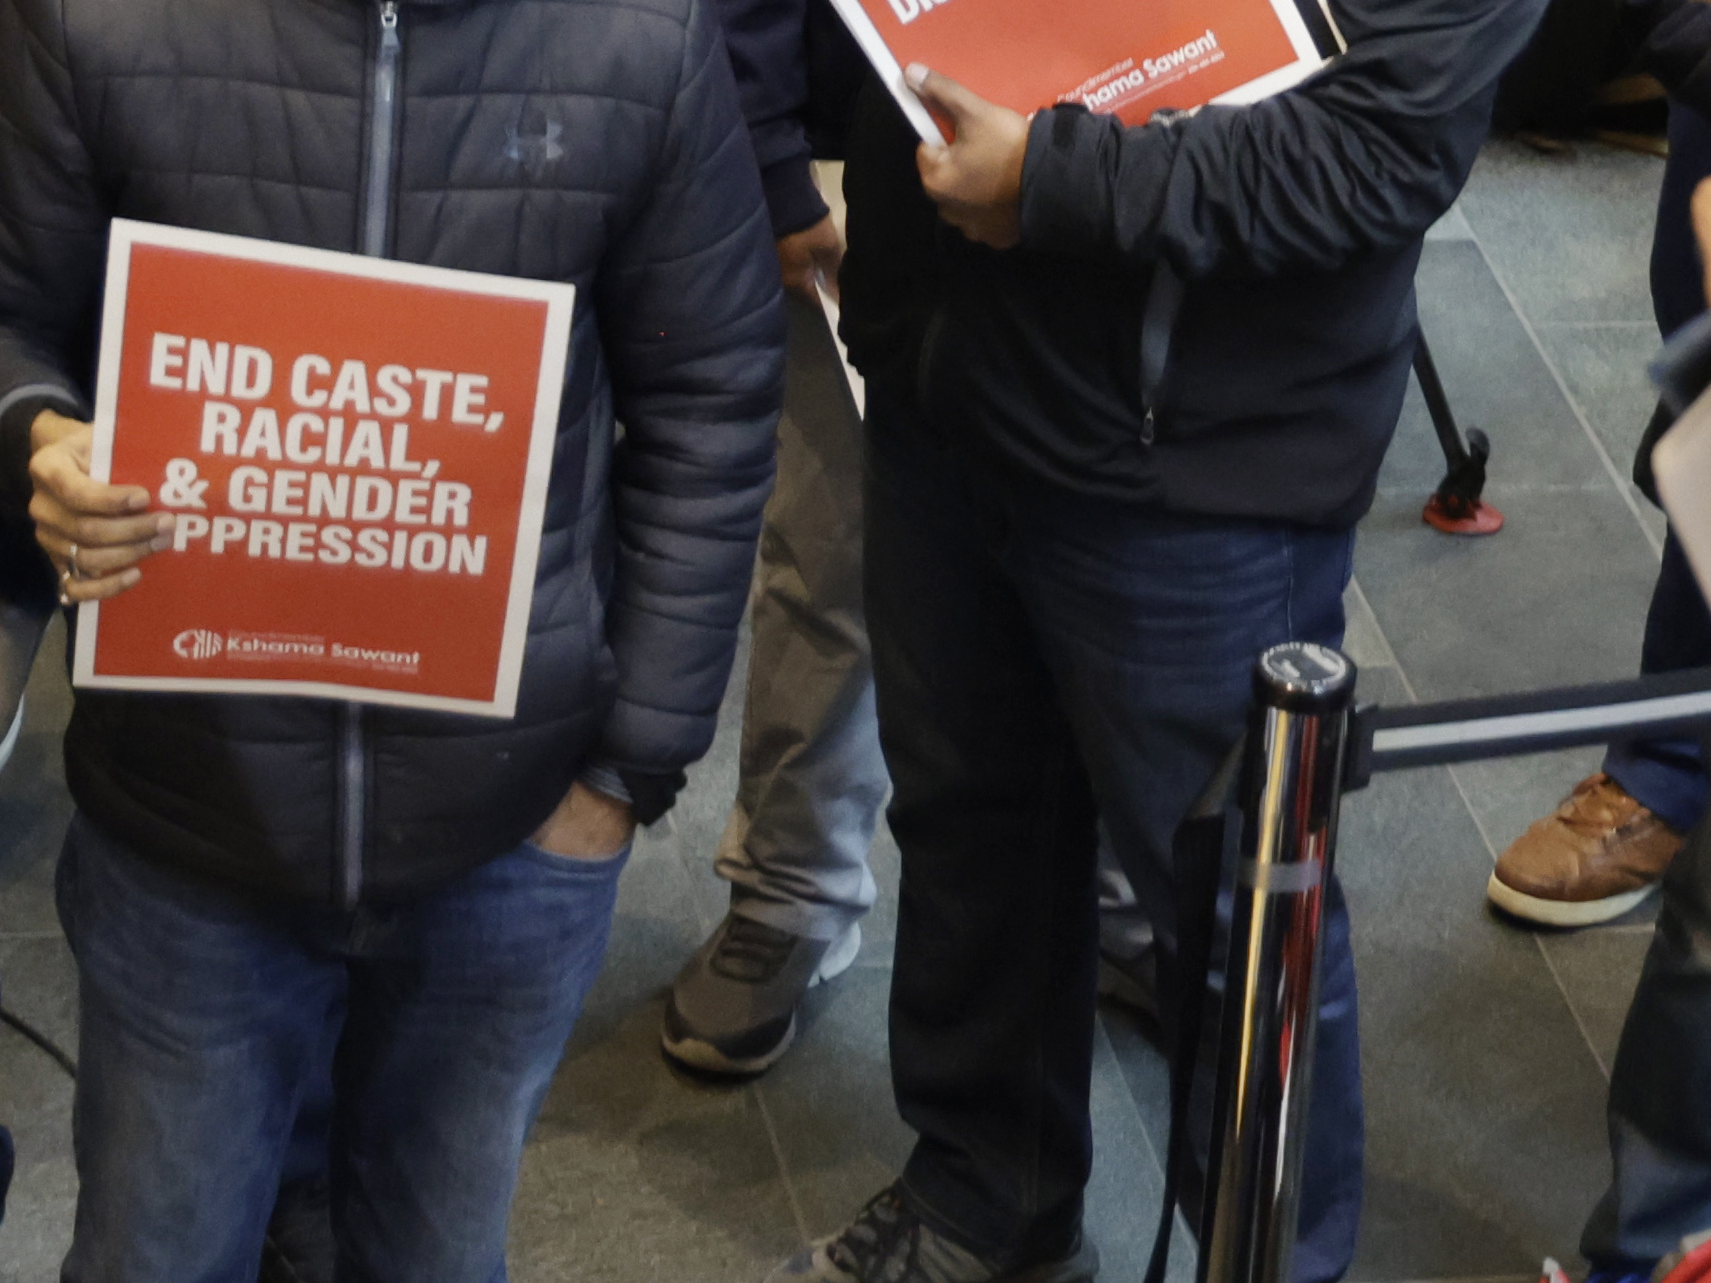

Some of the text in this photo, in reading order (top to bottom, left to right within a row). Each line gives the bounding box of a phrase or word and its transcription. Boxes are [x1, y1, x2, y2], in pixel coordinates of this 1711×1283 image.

[1082, 68, 1145, 112] hama
[1142, 29, 1219, 79] Sawant
[148, 332, 505, 434] END CASTE,
[200, 400, 440, 480] RACIAL,
[159, 458, 473, 528] & GENDER
[172, 514, 489, 576] PPRESSION
[227, 637, 420, 664] Kshama Sawant
